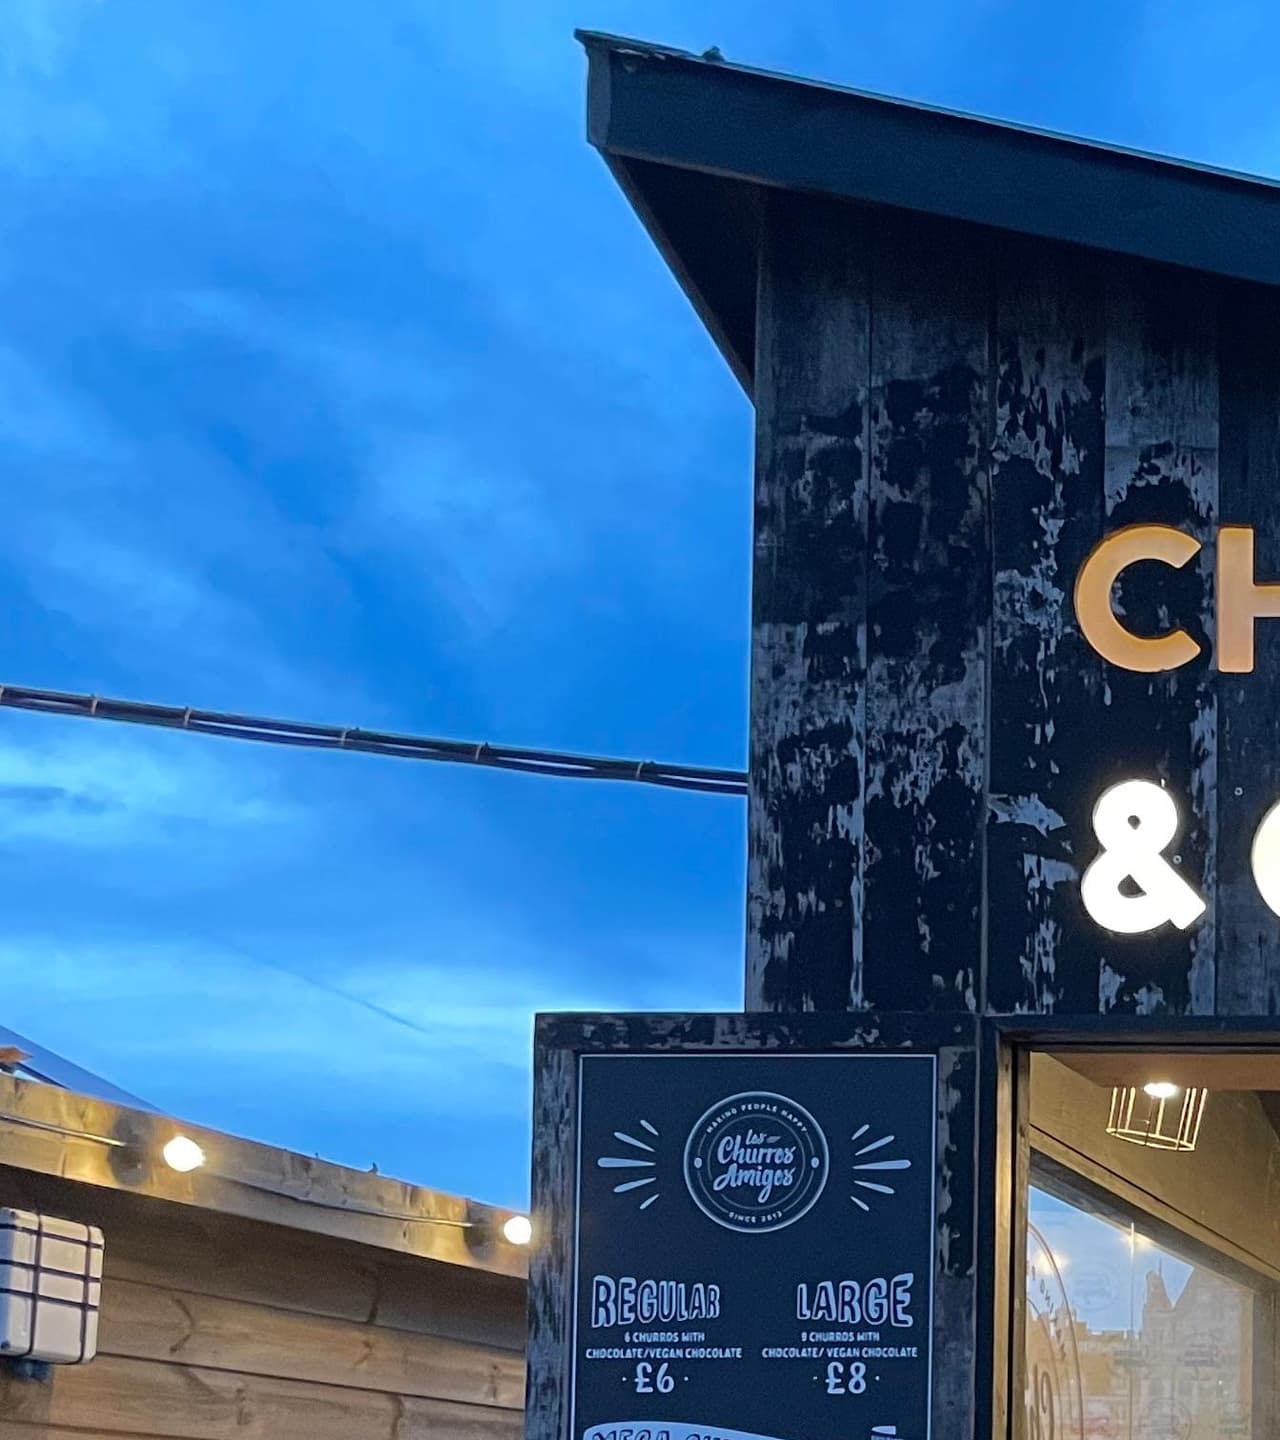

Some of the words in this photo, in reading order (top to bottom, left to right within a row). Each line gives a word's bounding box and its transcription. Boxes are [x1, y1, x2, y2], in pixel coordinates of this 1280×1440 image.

[1081, 778, 1205, 935] &
[741, 1103, 777, 1113] PEOPLE
[781, 1109, 808, 1132] HAPPY
[717, 1135, 796, 1164] Churros
[713, 1163, 796, 1203] Amigos
[729, 1211, 756, 1223] SINCE
[591, 1275, 720, 1328] REGULAR
[797, 1273, 914, 1327] LARGE
[633, 1332, 679, 1342] CHURROS
[682, 1332, 705, 1342] WITH
[809, 1332, 854, 1342] CHURROS
[857, 1332, 880, 1342] WITH
[685, 1348, 743, 1358] CHOCOLATE
[827, 1347, 860, 1358] VEGAN
[861, 1347, 918, 1358] CHOCOLATE
[634, 1362, 674, 1393] £6
[825, 1361, 866, 1394] £8
